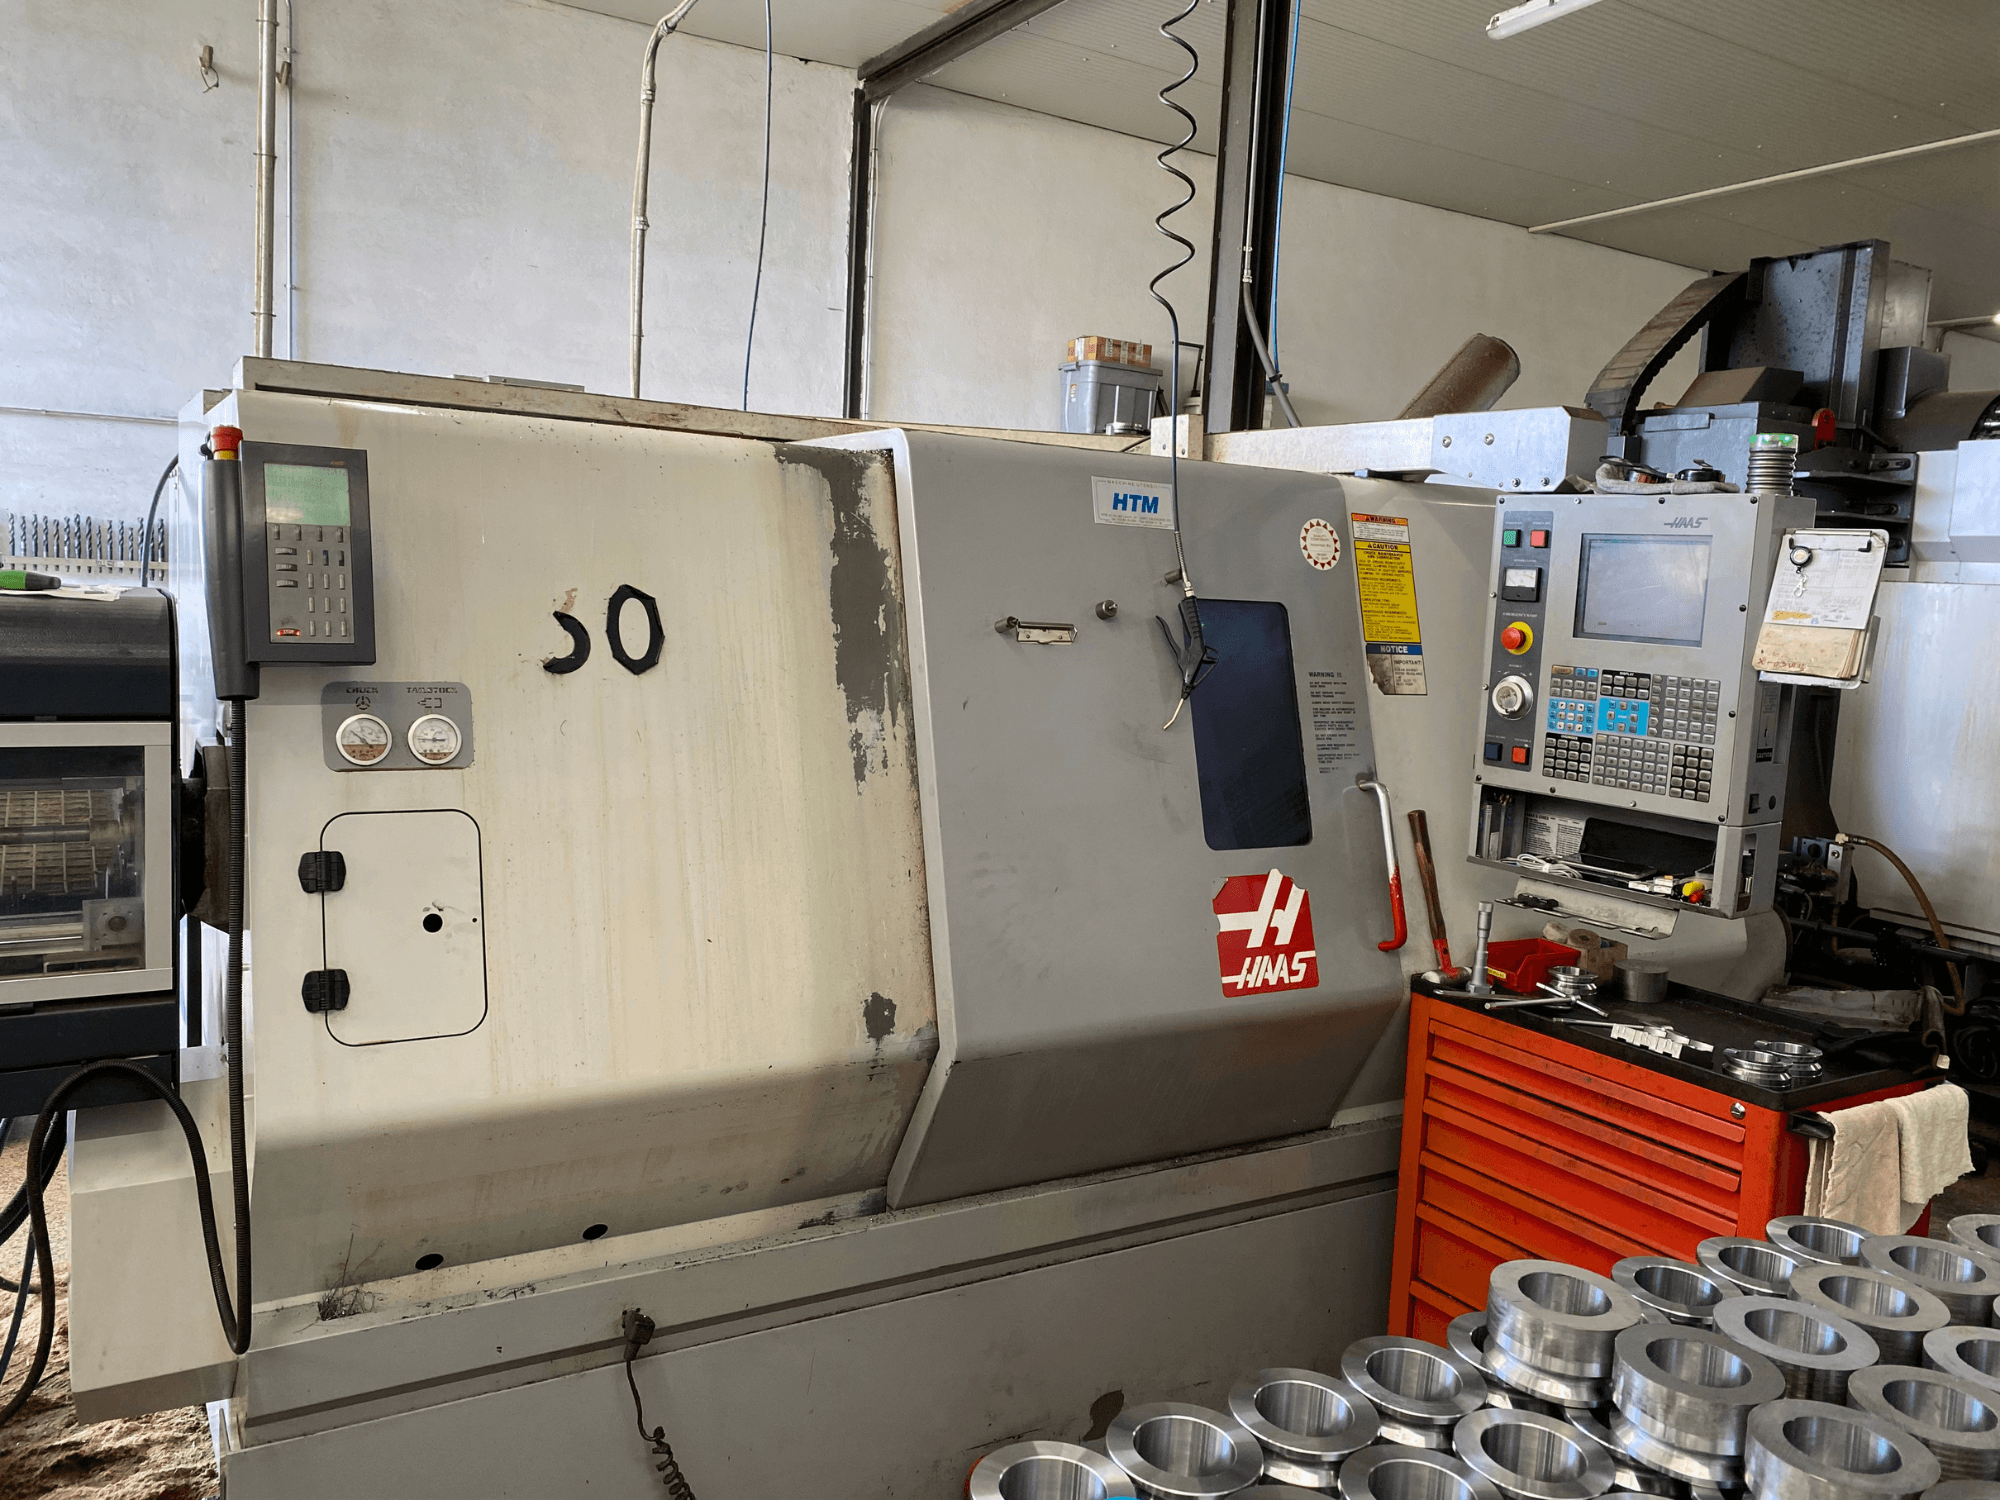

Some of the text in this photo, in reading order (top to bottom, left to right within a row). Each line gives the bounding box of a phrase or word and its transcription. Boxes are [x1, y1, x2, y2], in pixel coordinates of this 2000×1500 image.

[1112, 492, 1159, 514] HTM
[1663, 517, 1709, 528] HAAS
[1380, 645, 1409, 654] NOTICE
[345, 686, 458, 694] CHUCK TAILSTOCK
[1221, 950, 1317, 989] HAAS
